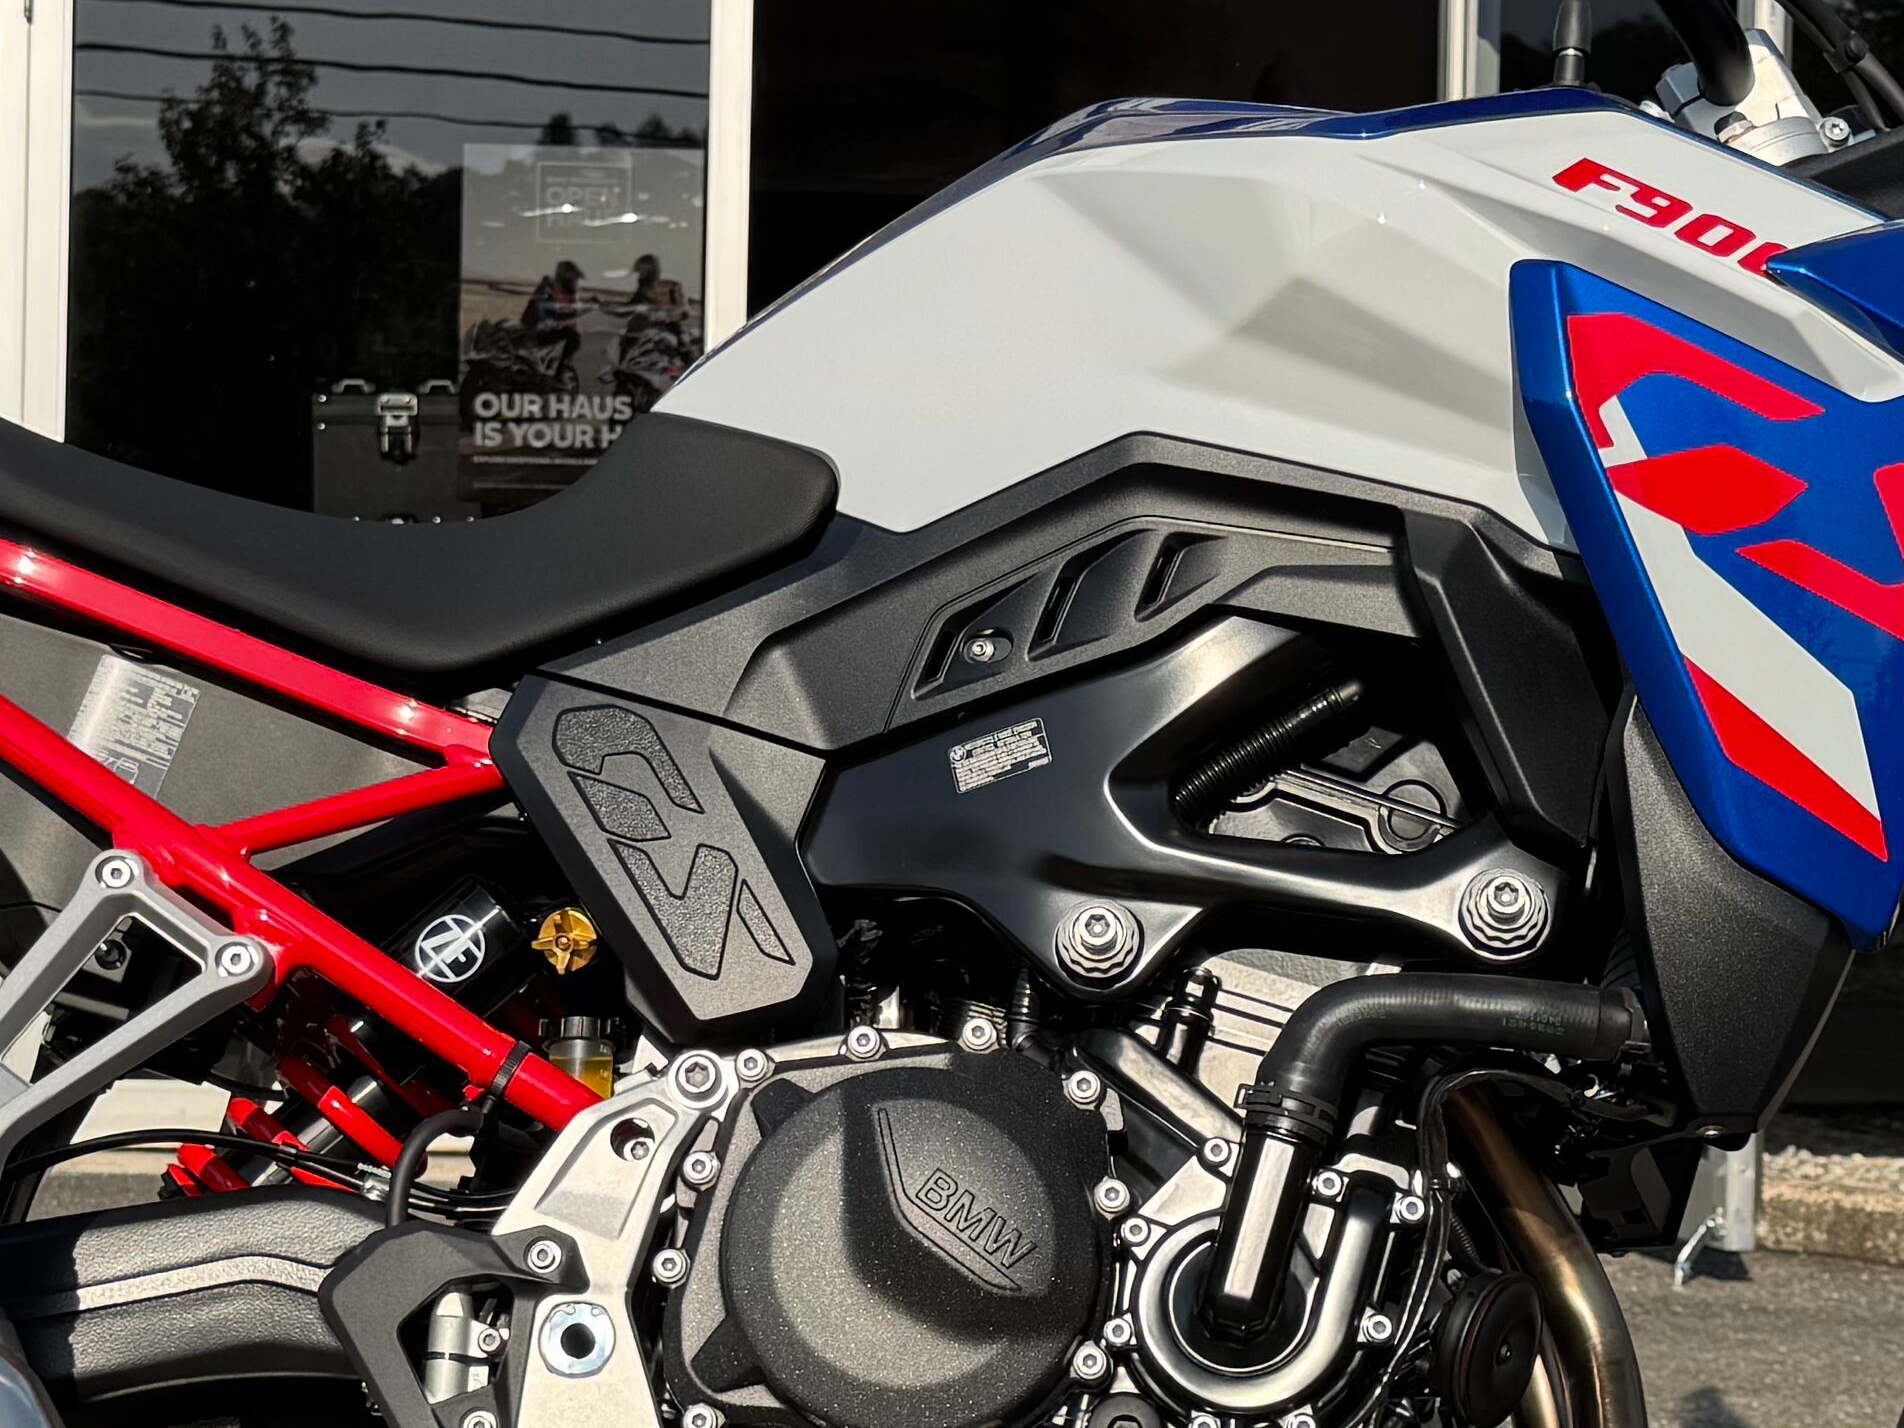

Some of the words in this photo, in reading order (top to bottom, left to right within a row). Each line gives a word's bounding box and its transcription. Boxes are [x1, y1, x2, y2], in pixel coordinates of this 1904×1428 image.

[472, 391, 543, 419] OUR
[548, 393, 634, 421] HAUS
[472, 421, 504, 448] IS
[508, 423, 596, 450] YOUR
[916, 1168, 1038, 1270] BMW
